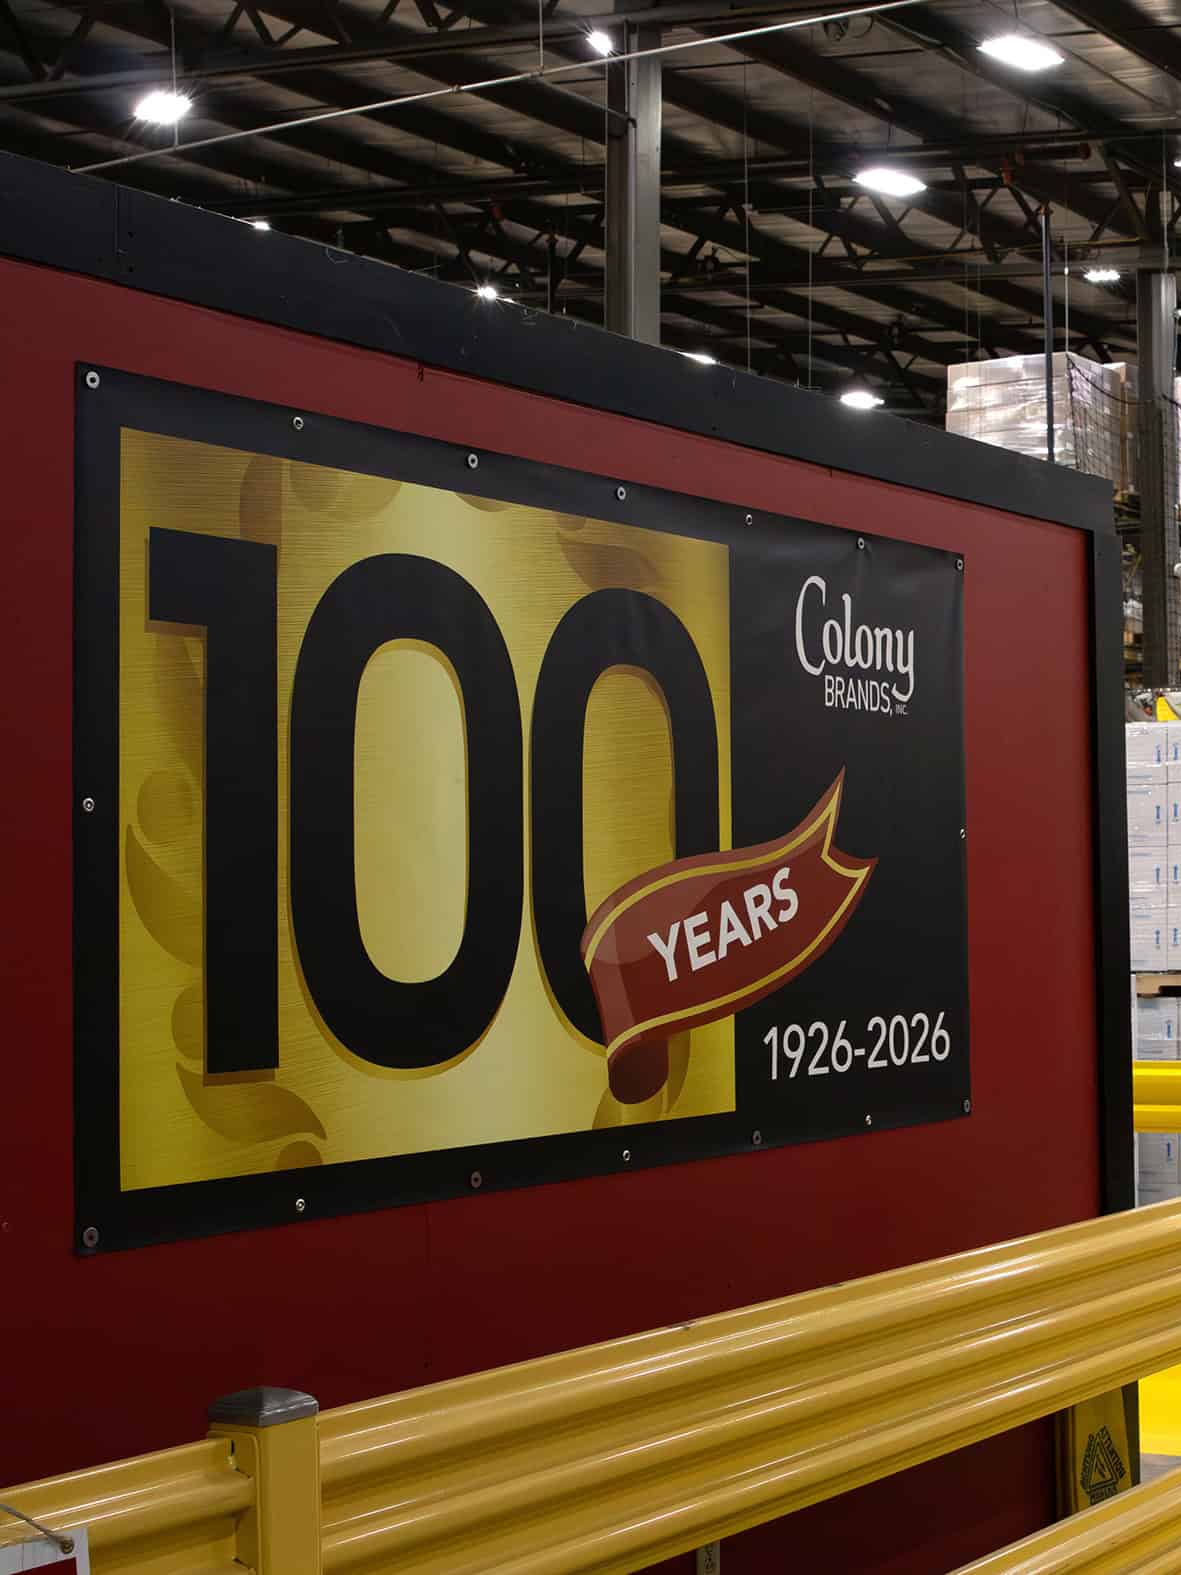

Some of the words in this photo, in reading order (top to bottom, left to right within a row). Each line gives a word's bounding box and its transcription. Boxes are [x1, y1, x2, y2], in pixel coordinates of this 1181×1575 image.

[796, 575, 914, 702] Colony
[824, 675, 893, 717] BRANDS,
[148, 526, 720, 1074] 100
[646, 866, 800, 983] YEARS
[763, 1011, 952, 1081] 1926-2026
